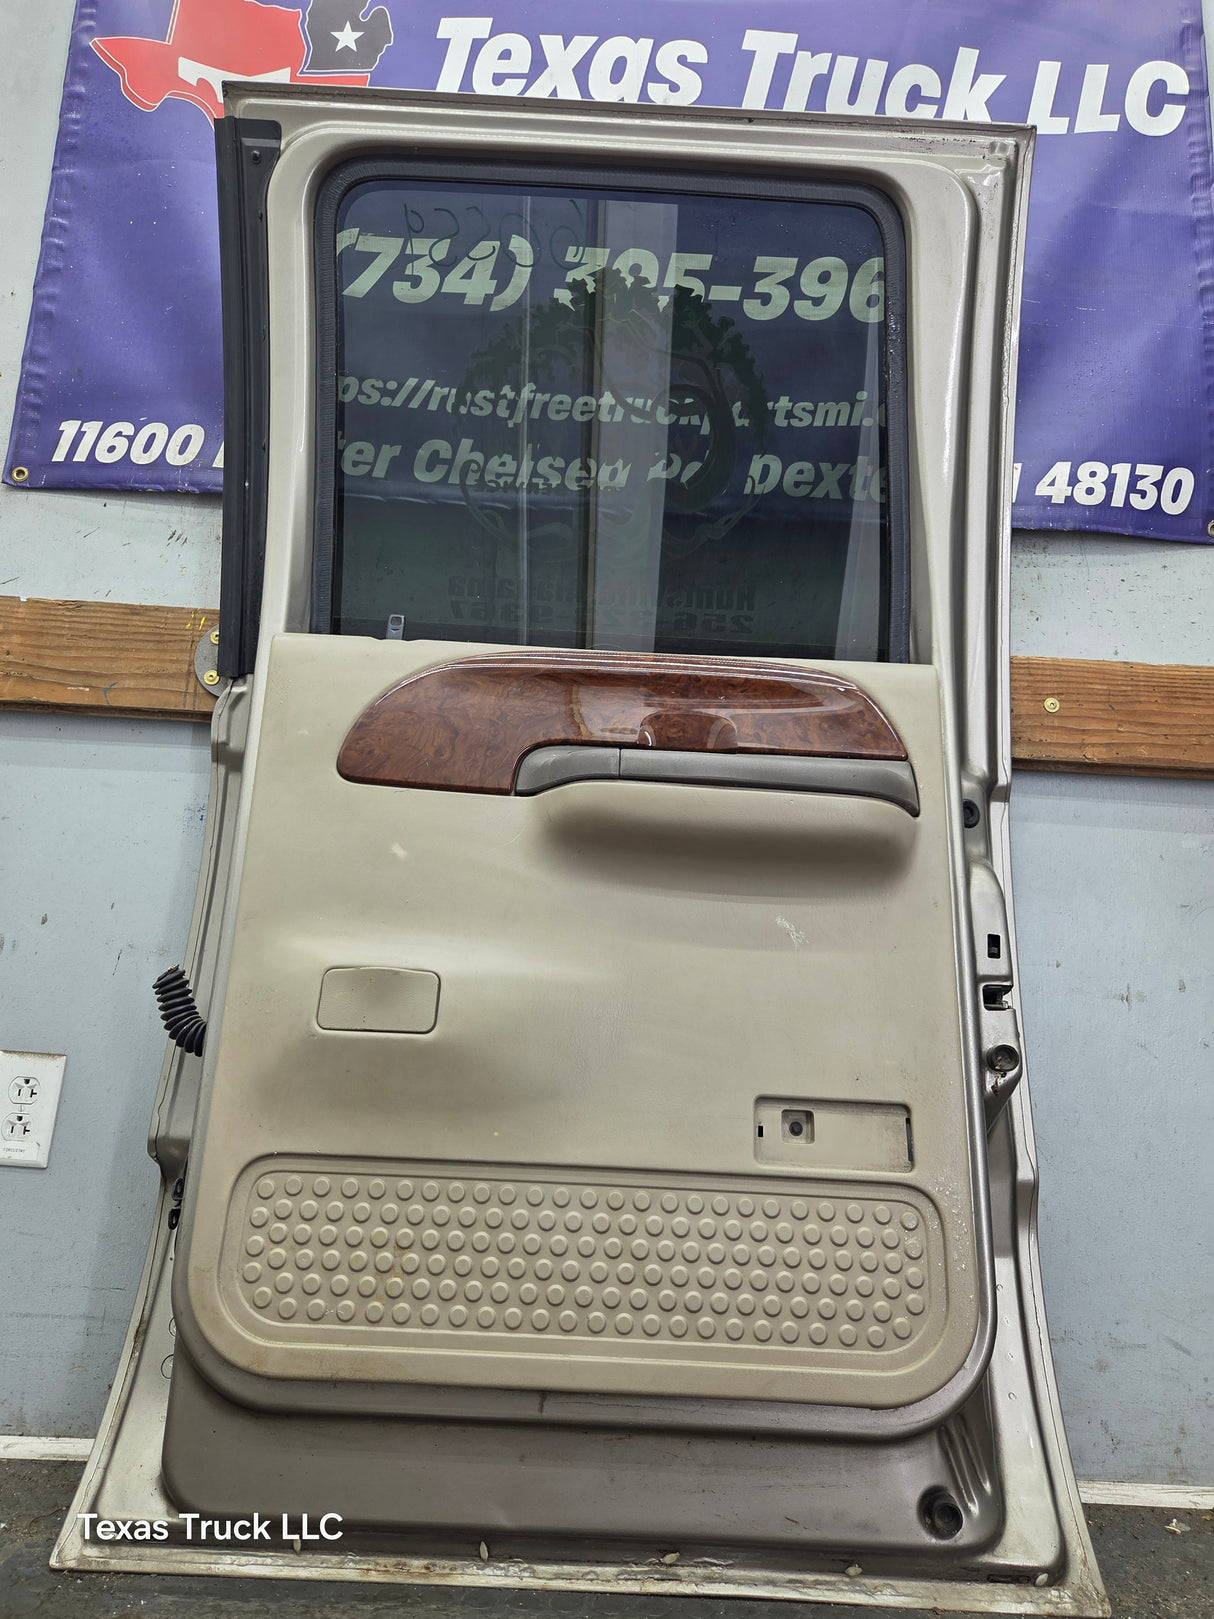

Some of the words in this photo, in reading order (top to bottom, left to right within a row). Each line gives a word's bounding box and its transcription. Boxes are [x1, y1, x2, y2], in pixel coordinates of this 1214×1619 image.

[436, 17, 708, 106] Texas
[741, 29, 1007, 122] Truck
[1026, 60, 1190, 136] LLC
[51, 420, 206, 466] 11600
[413, 437, 632, 491] Chelsea
[1034, 461, 1195, 515] 48130
